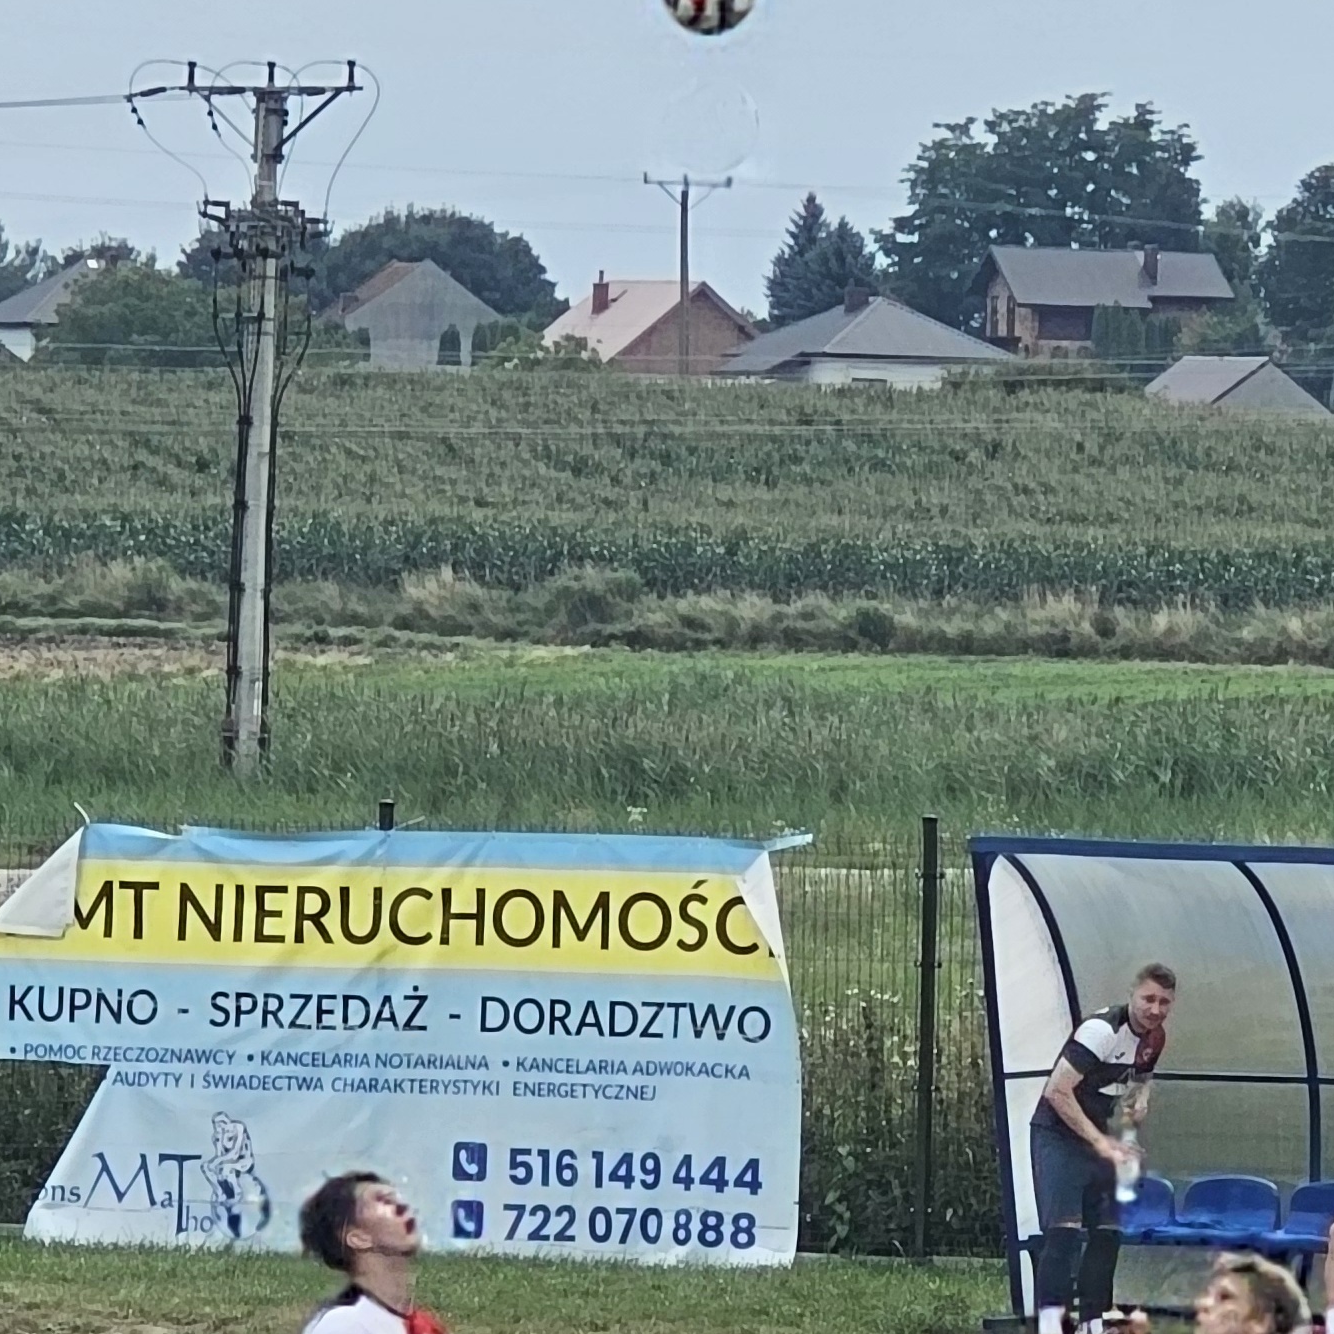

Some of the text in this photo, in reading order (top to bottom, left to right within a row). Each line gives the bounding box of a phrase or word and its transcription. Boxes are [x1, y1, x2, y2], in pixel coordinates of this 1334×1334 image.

[177, 879, 778, 958] NIERUCHOMOŚC
[8, 984, 159, 1026] KUPNO
[208, 985, 428, 1031] SPRZEDAŻ
[479, 996, 772, 1044] DORADZTWO
[23, 1043, 237, 1066] POMOC RZECZOZNAWCY
[260, 1050, 489, 1071] KANCELARIA NOTARIALNA
[516, 1056, 751, 1080] KANCELARIA ADWOKACKA
[112, 1069, 657, 1101] AUDYTY I ŚWIADECTWA CHARAKTERYSTYKI ENERGETYCZNEJ
[508, 1147, 763, 1196] 516 149 444
[503, 1203, 757, 1250] 722 070 888
